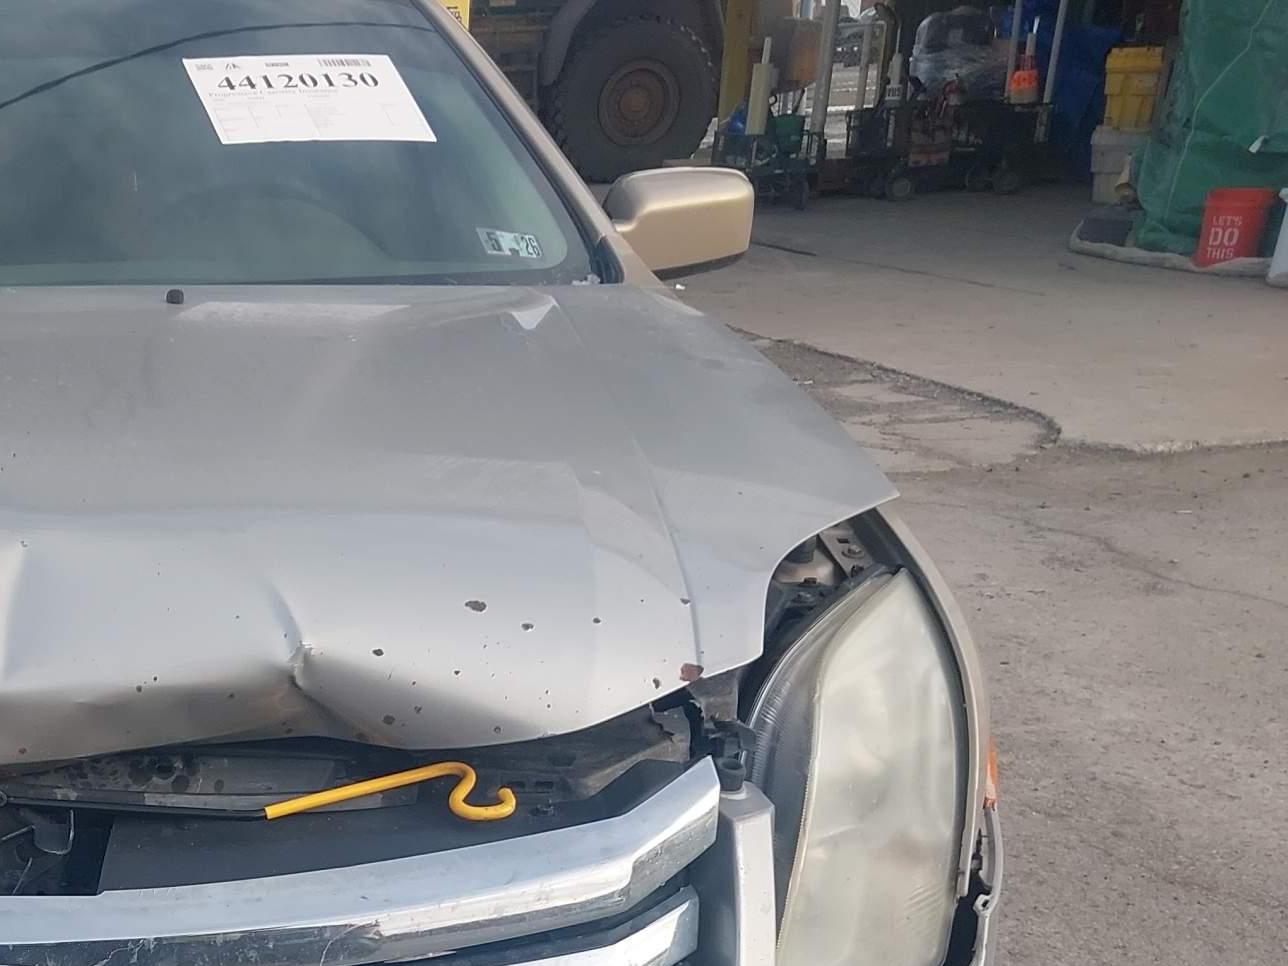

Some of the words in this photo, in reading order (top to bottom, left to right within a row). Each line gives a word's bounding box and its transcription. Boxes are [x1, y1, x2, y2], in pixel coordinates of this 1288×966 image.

[218, 72, 379, 91] 44120130
[1212, 215, 1243, 227] LET'S
[486, 231, 503, 252] 5
[520, 234, 541, 257] 26
[1208, 227, 1240, 247] DO
[1207, 247, 1235, 260] THIS
